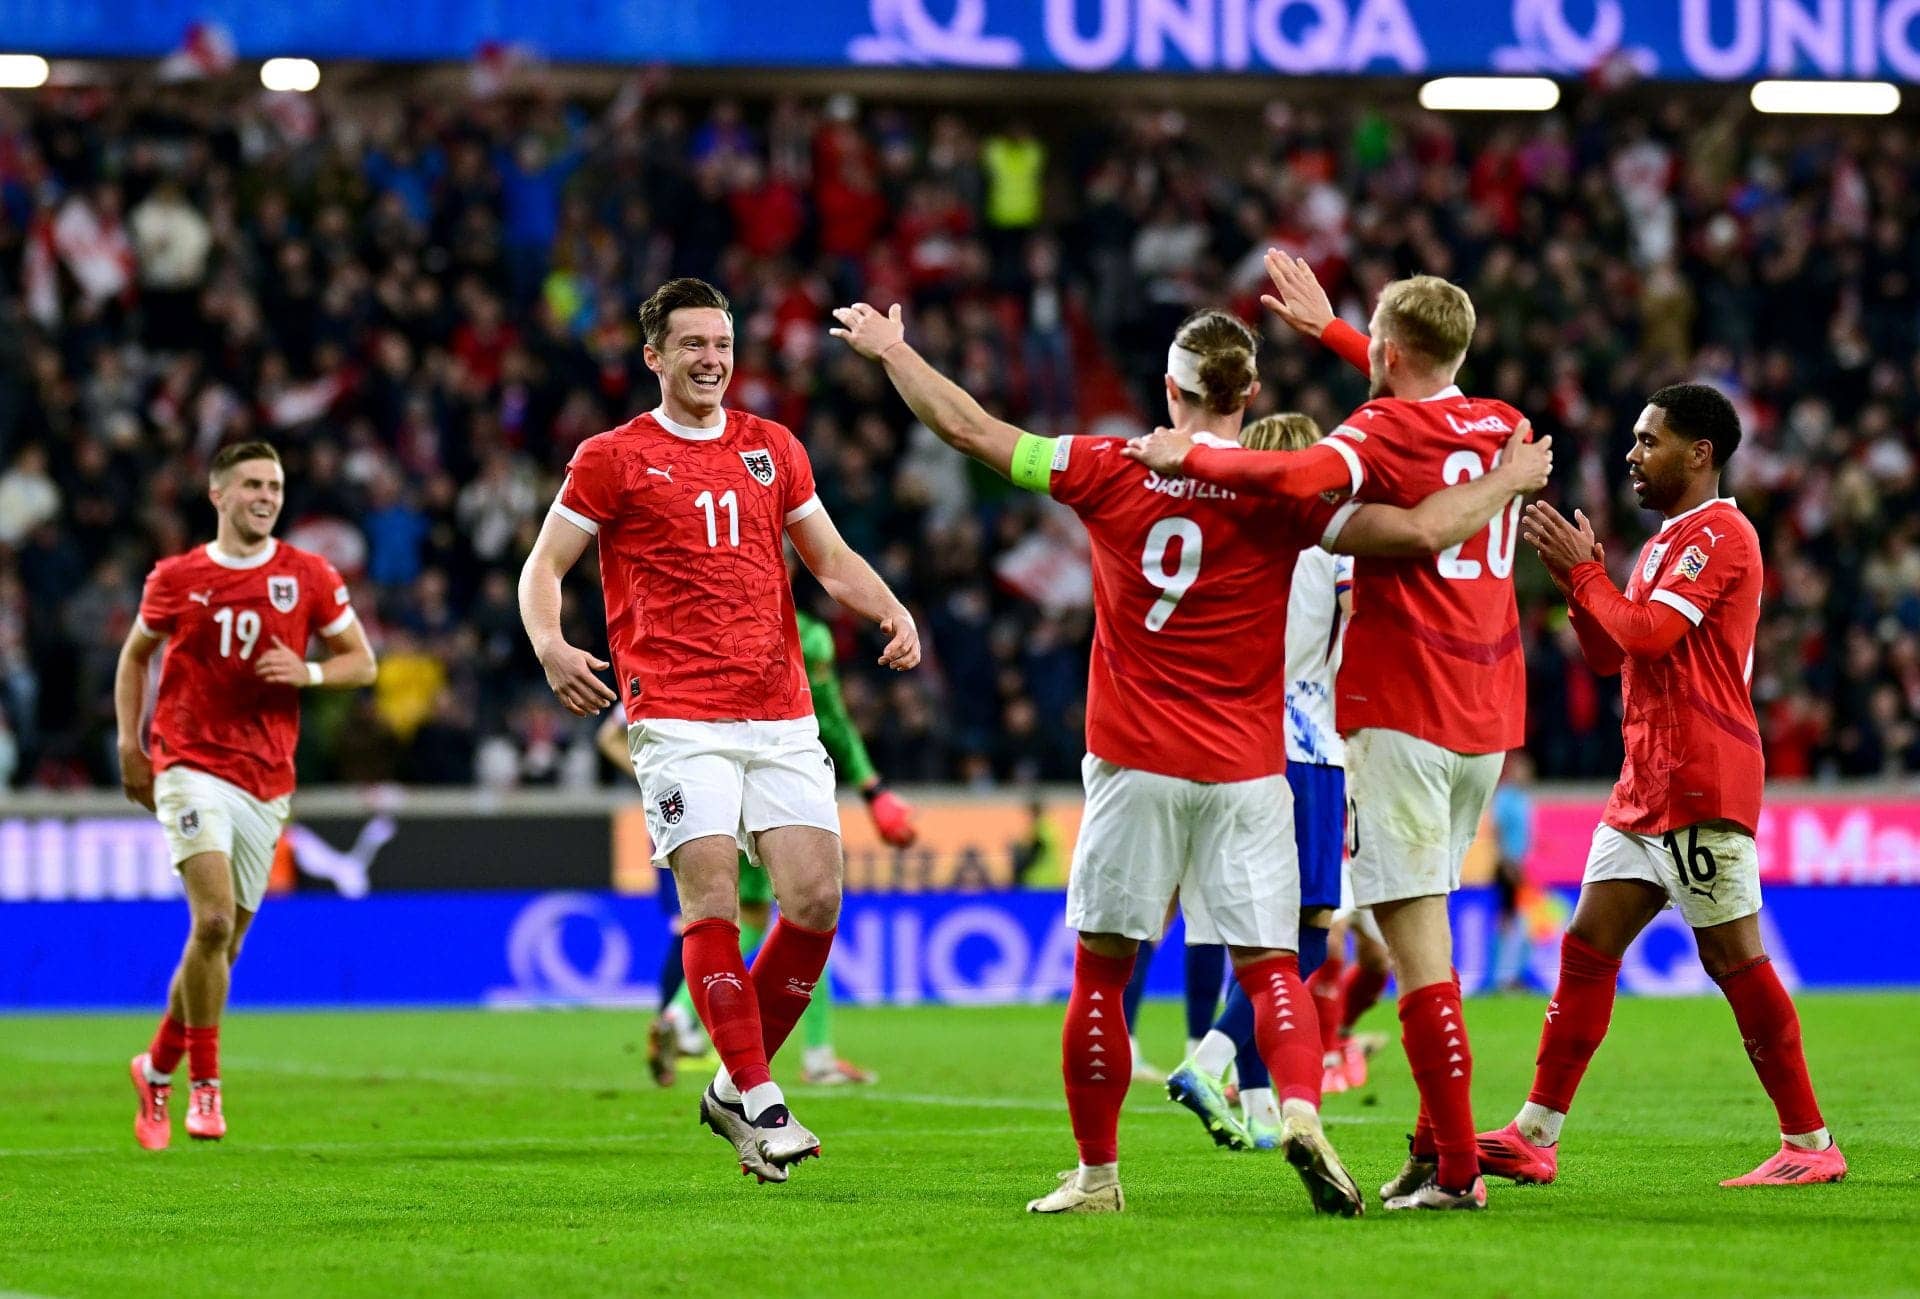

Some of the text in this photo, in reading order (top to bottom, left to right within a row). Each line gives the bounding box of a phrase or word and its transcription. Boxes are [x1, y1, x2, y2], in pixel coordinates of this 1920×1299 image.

[1043, 0, 1427, 74] UNIQA
[694, 490, 739, 548] 11
[1437, 450, 1523, 579] 20
[1142, 517, 1203, 632] 9
[214, 607, 261, 660] 19
[1663, 825, 1717, 886] 16
[828, 905, 1078, 1006] NIQA
